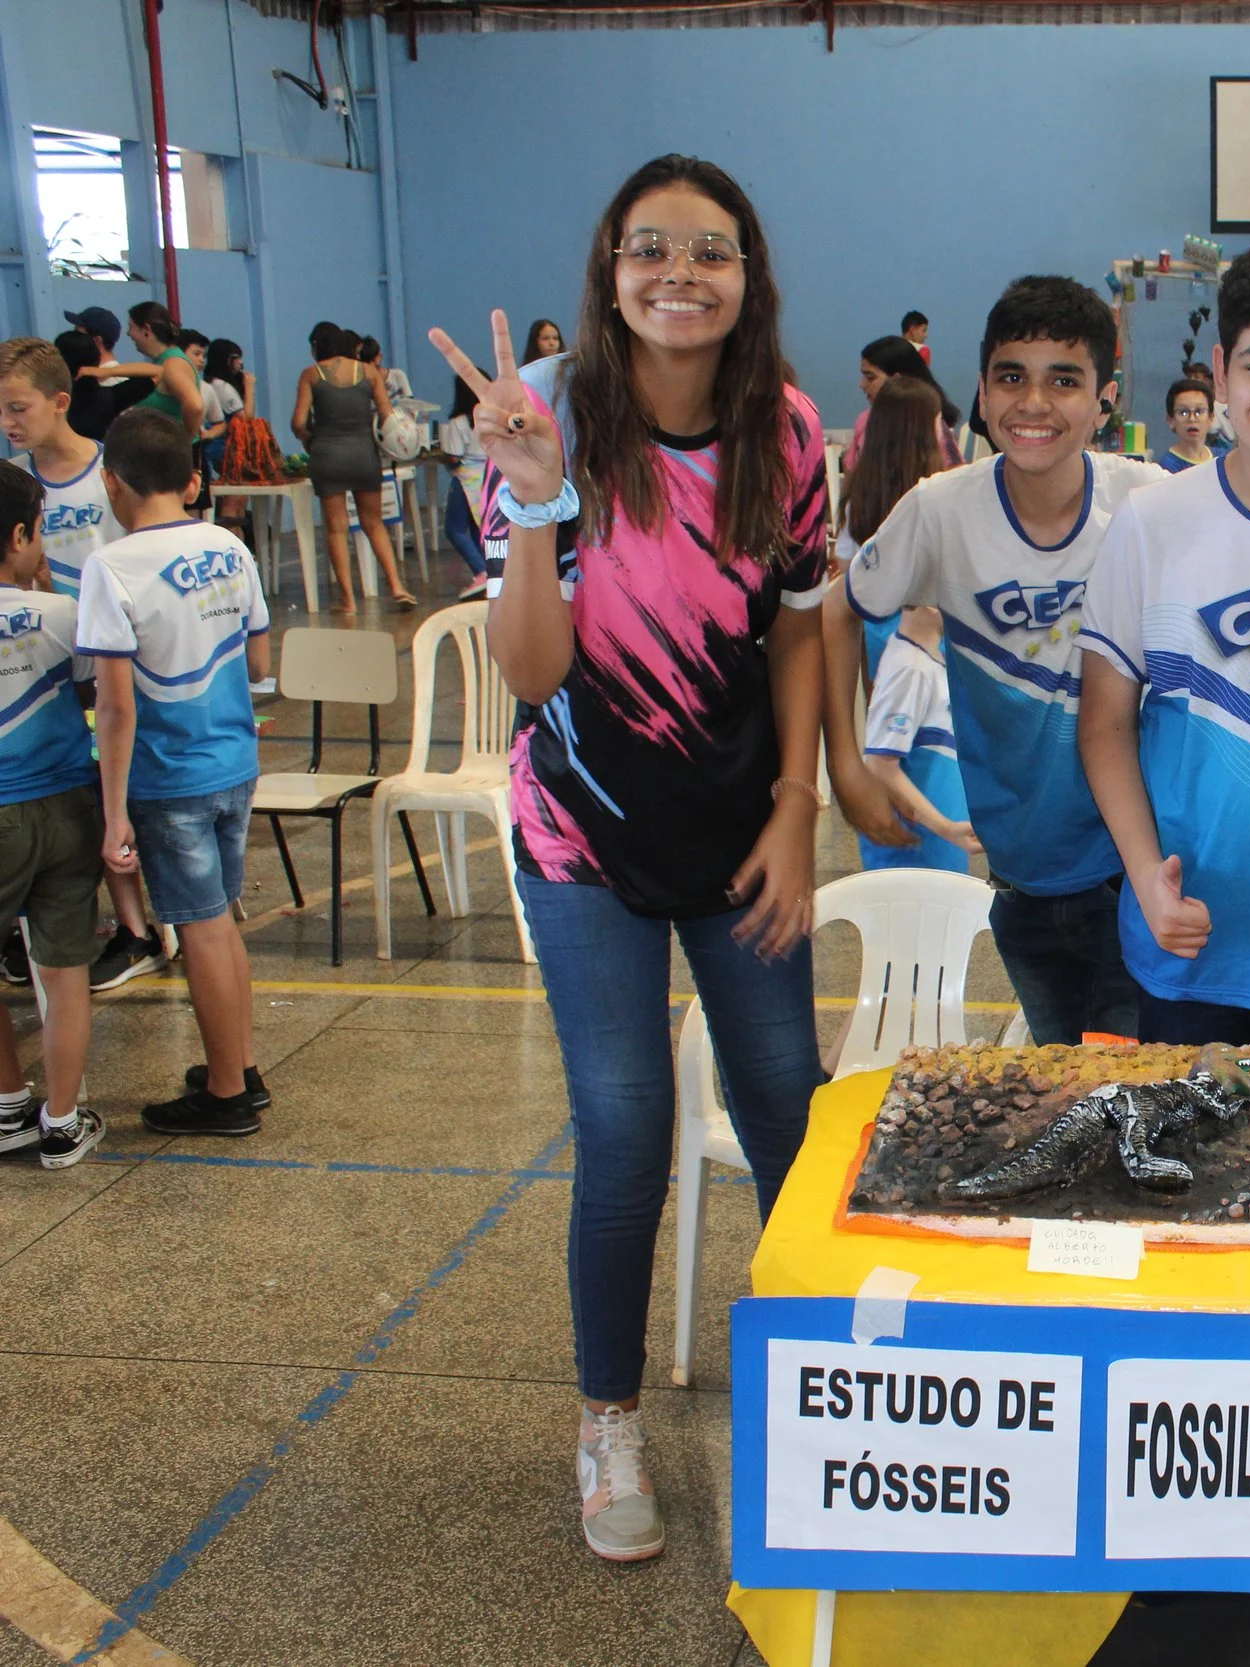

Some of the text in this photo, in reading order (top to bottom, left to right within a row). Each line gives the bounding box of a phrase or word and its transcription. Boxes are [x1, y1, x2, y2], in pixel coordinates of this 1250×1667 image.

[799, 1366, 1056, 1432] ESTUDO DE
[823, 1450, 1011, 1516] FÓSSEIS
